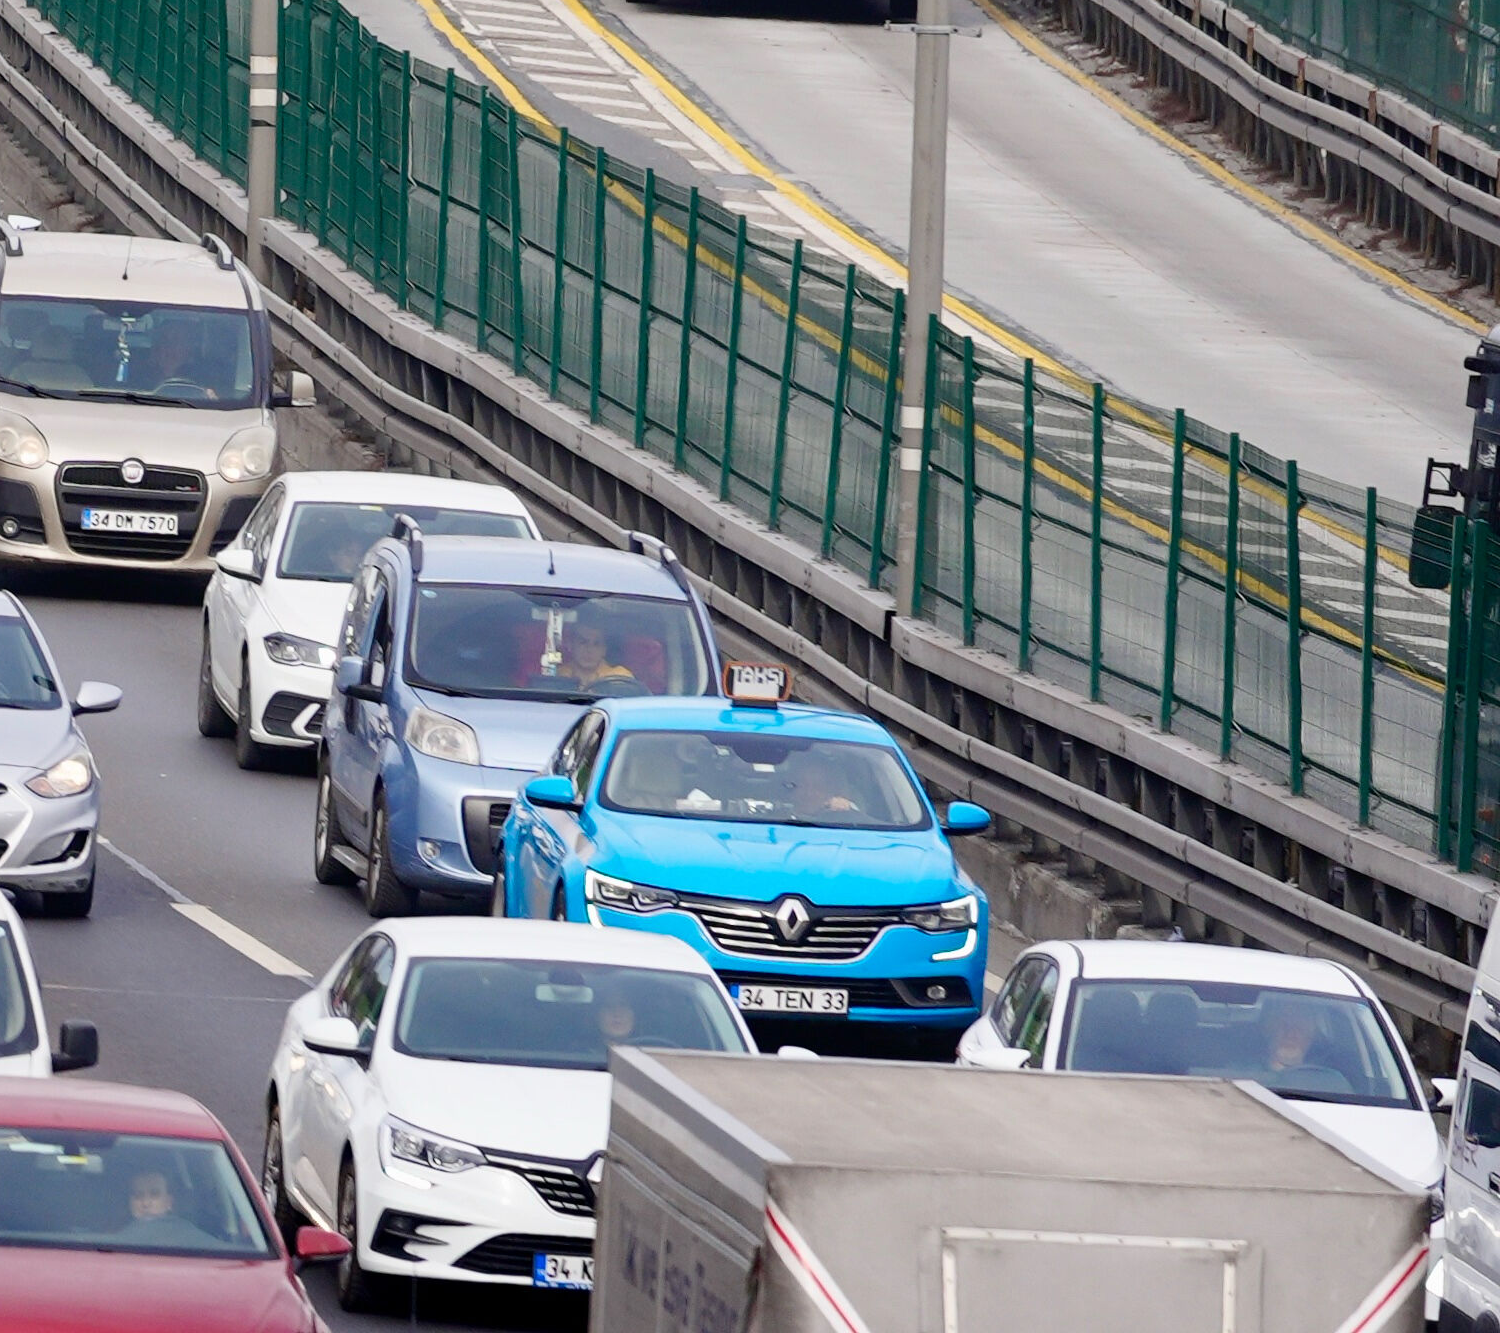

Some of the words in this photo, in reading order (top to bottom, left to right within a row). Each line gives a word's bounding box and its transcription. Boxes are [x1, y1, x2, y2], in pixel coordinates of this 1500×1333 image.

[91, 513, 109, 527] 34
[139, 516, 177, 531] 7570
[741, 988, 764, 1008] 34
[773, 990, 814, 1011] TEN
[821, 992, 846, 1012] 33
[546, 1257, 570, 1280] 34
